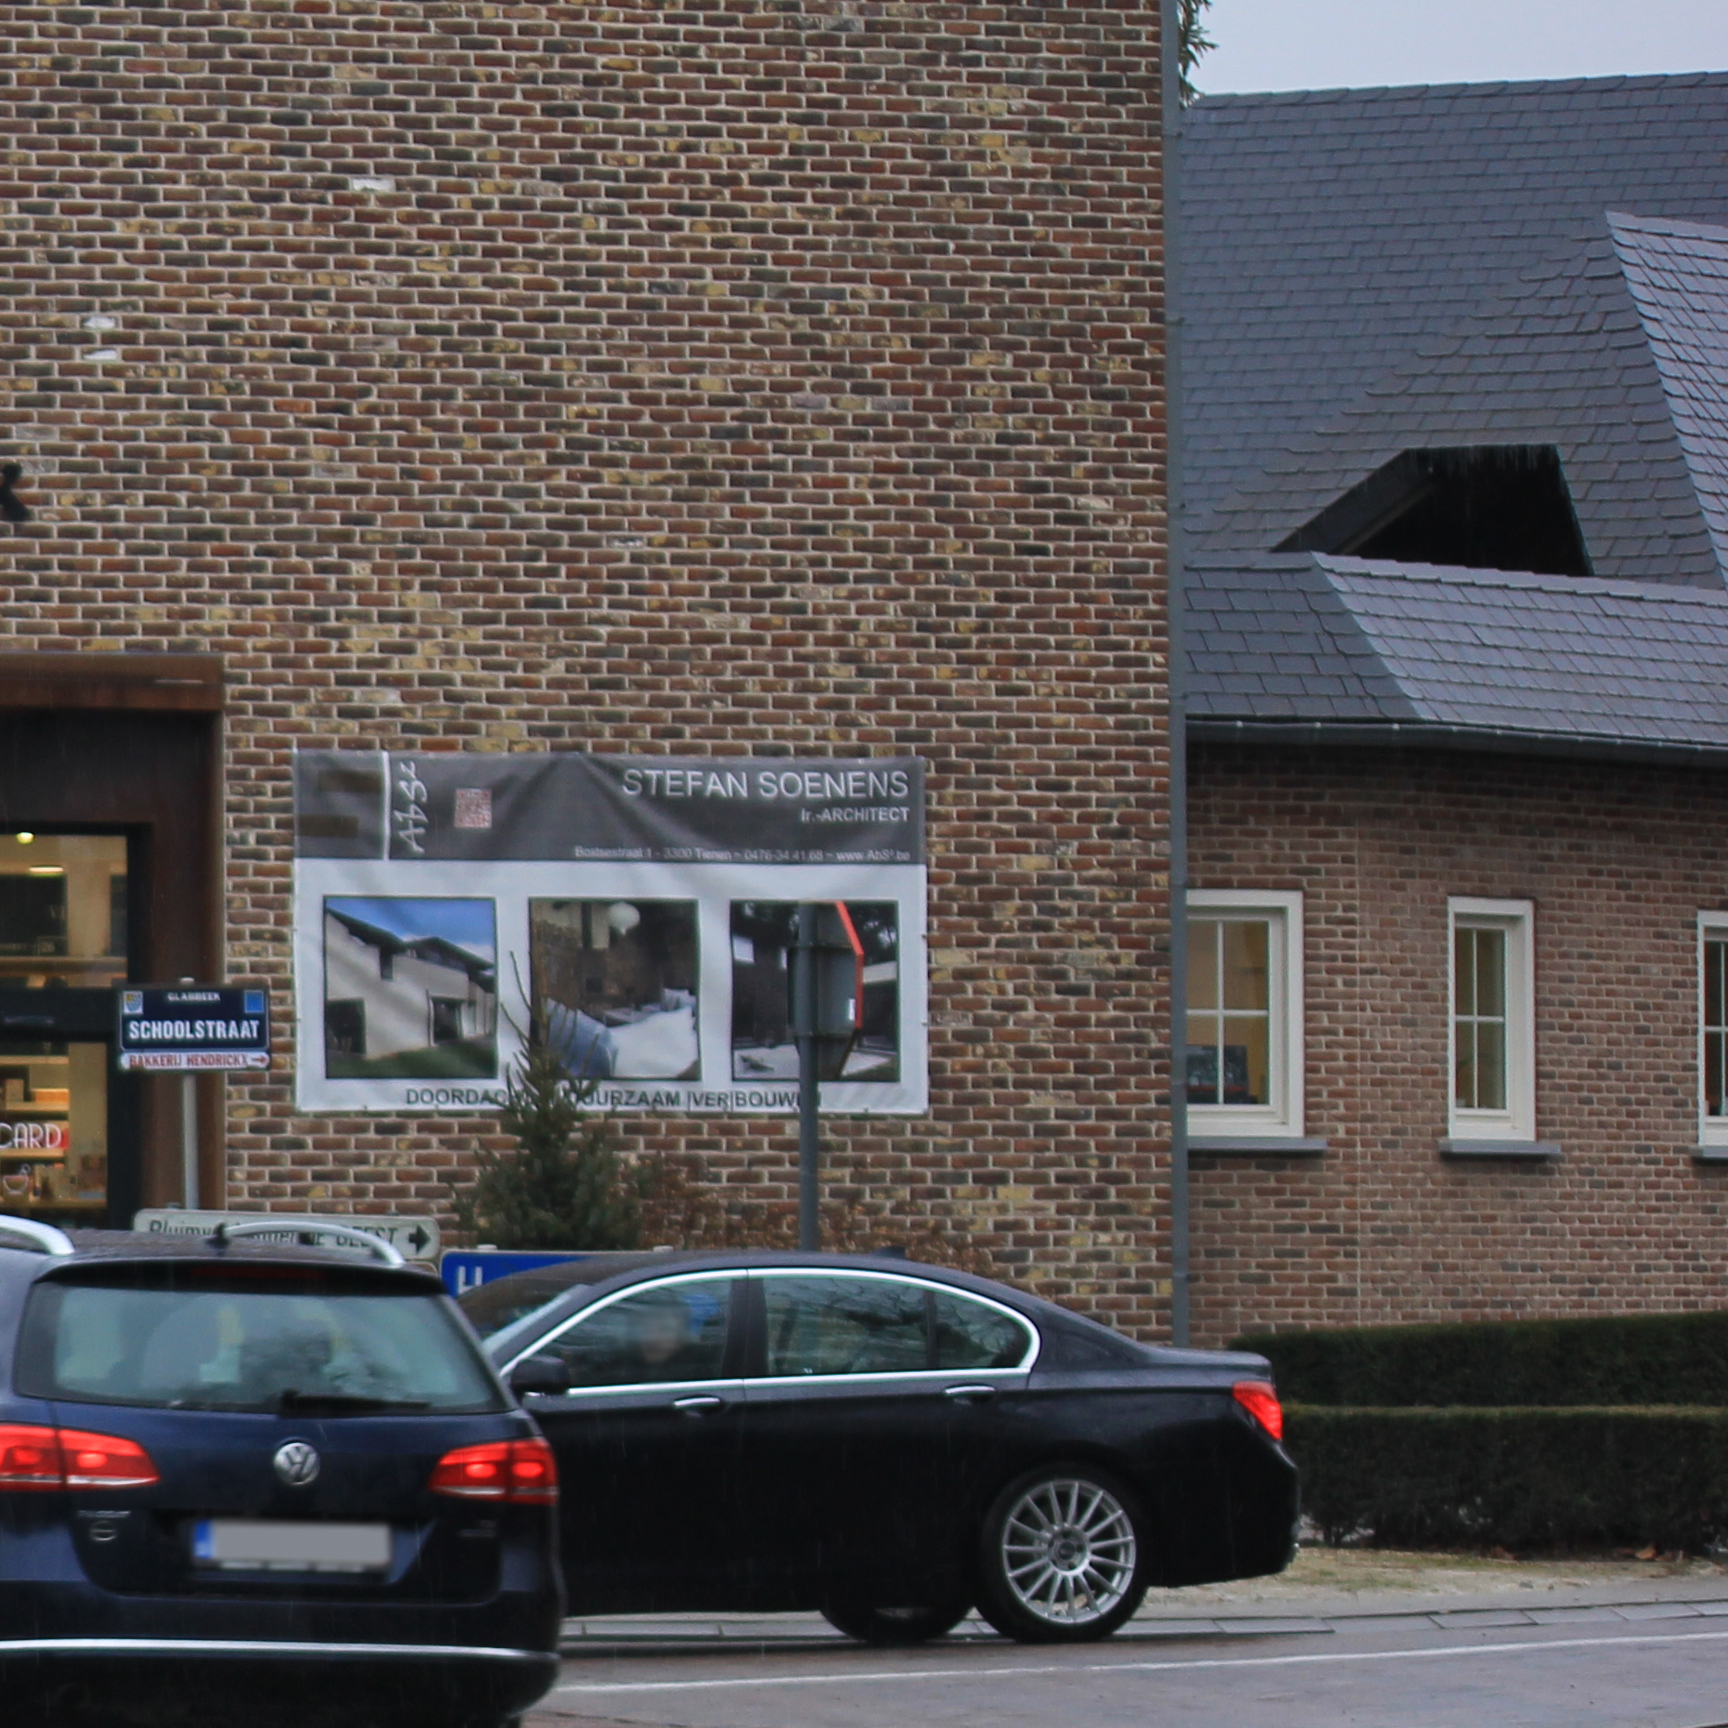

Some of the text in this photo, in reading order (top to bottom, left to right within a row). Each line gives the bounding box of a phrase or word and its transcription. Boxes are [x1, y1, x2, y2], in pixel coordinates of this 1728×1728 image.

[622, 768, 909, 799] STEFAN SOENENS
[129, 1019, 260, 1039] SCHOOLSTRAAT
[130, 1053, 248, 1067] BAKKERIJ HENDRICKX
